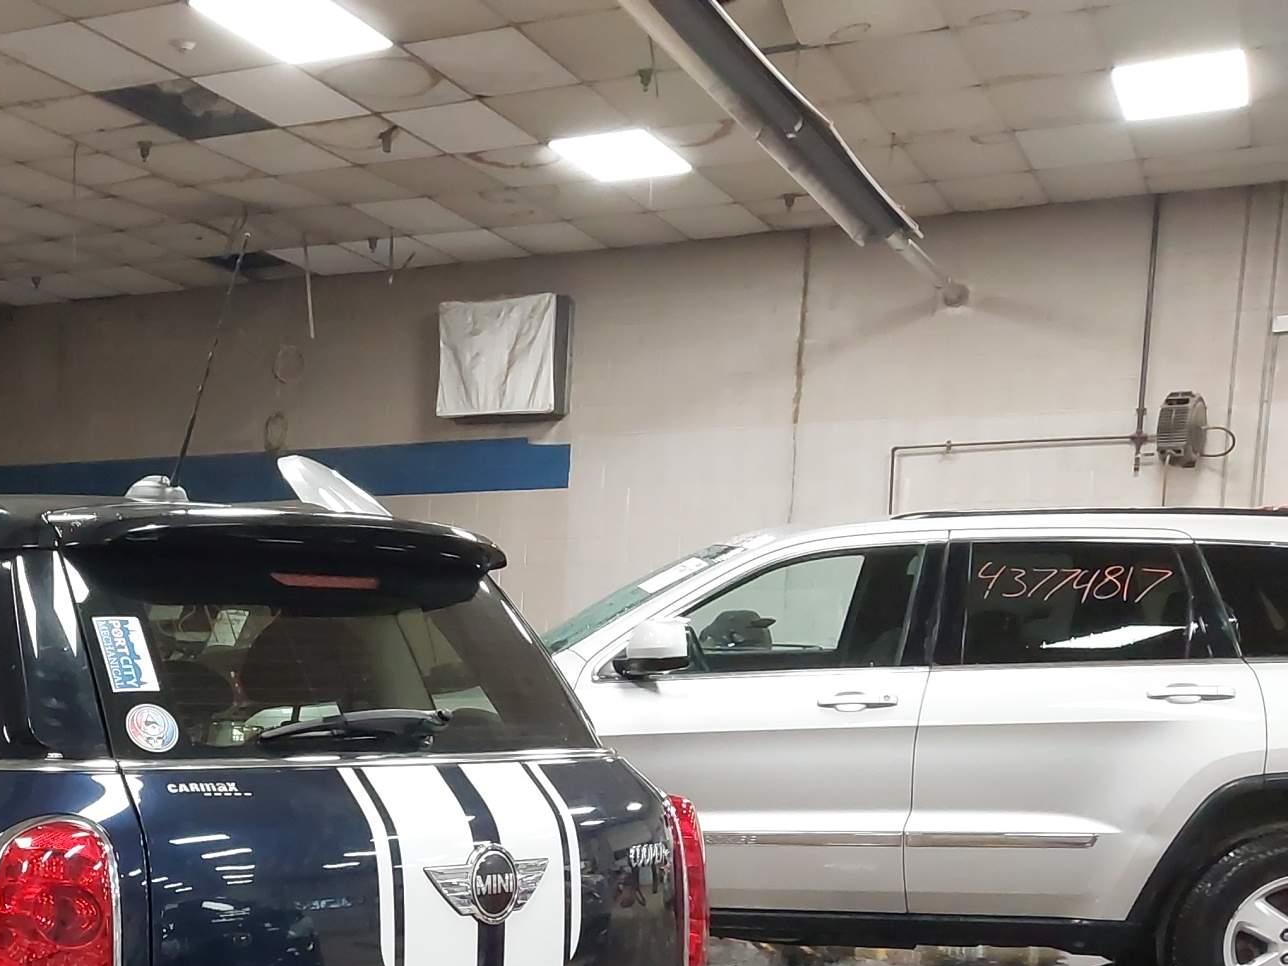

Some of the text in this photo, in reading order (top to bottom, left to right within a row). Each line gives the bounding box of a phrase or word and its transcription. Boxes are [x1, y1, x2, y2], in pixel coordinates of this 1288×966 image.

[978, 561, 1173, 604] 43774817
[97, 619, 125, 689] MECHANICAL
[109, 619, 139, 688] PORT CITY
[476, 872, 514, 896] MINI
